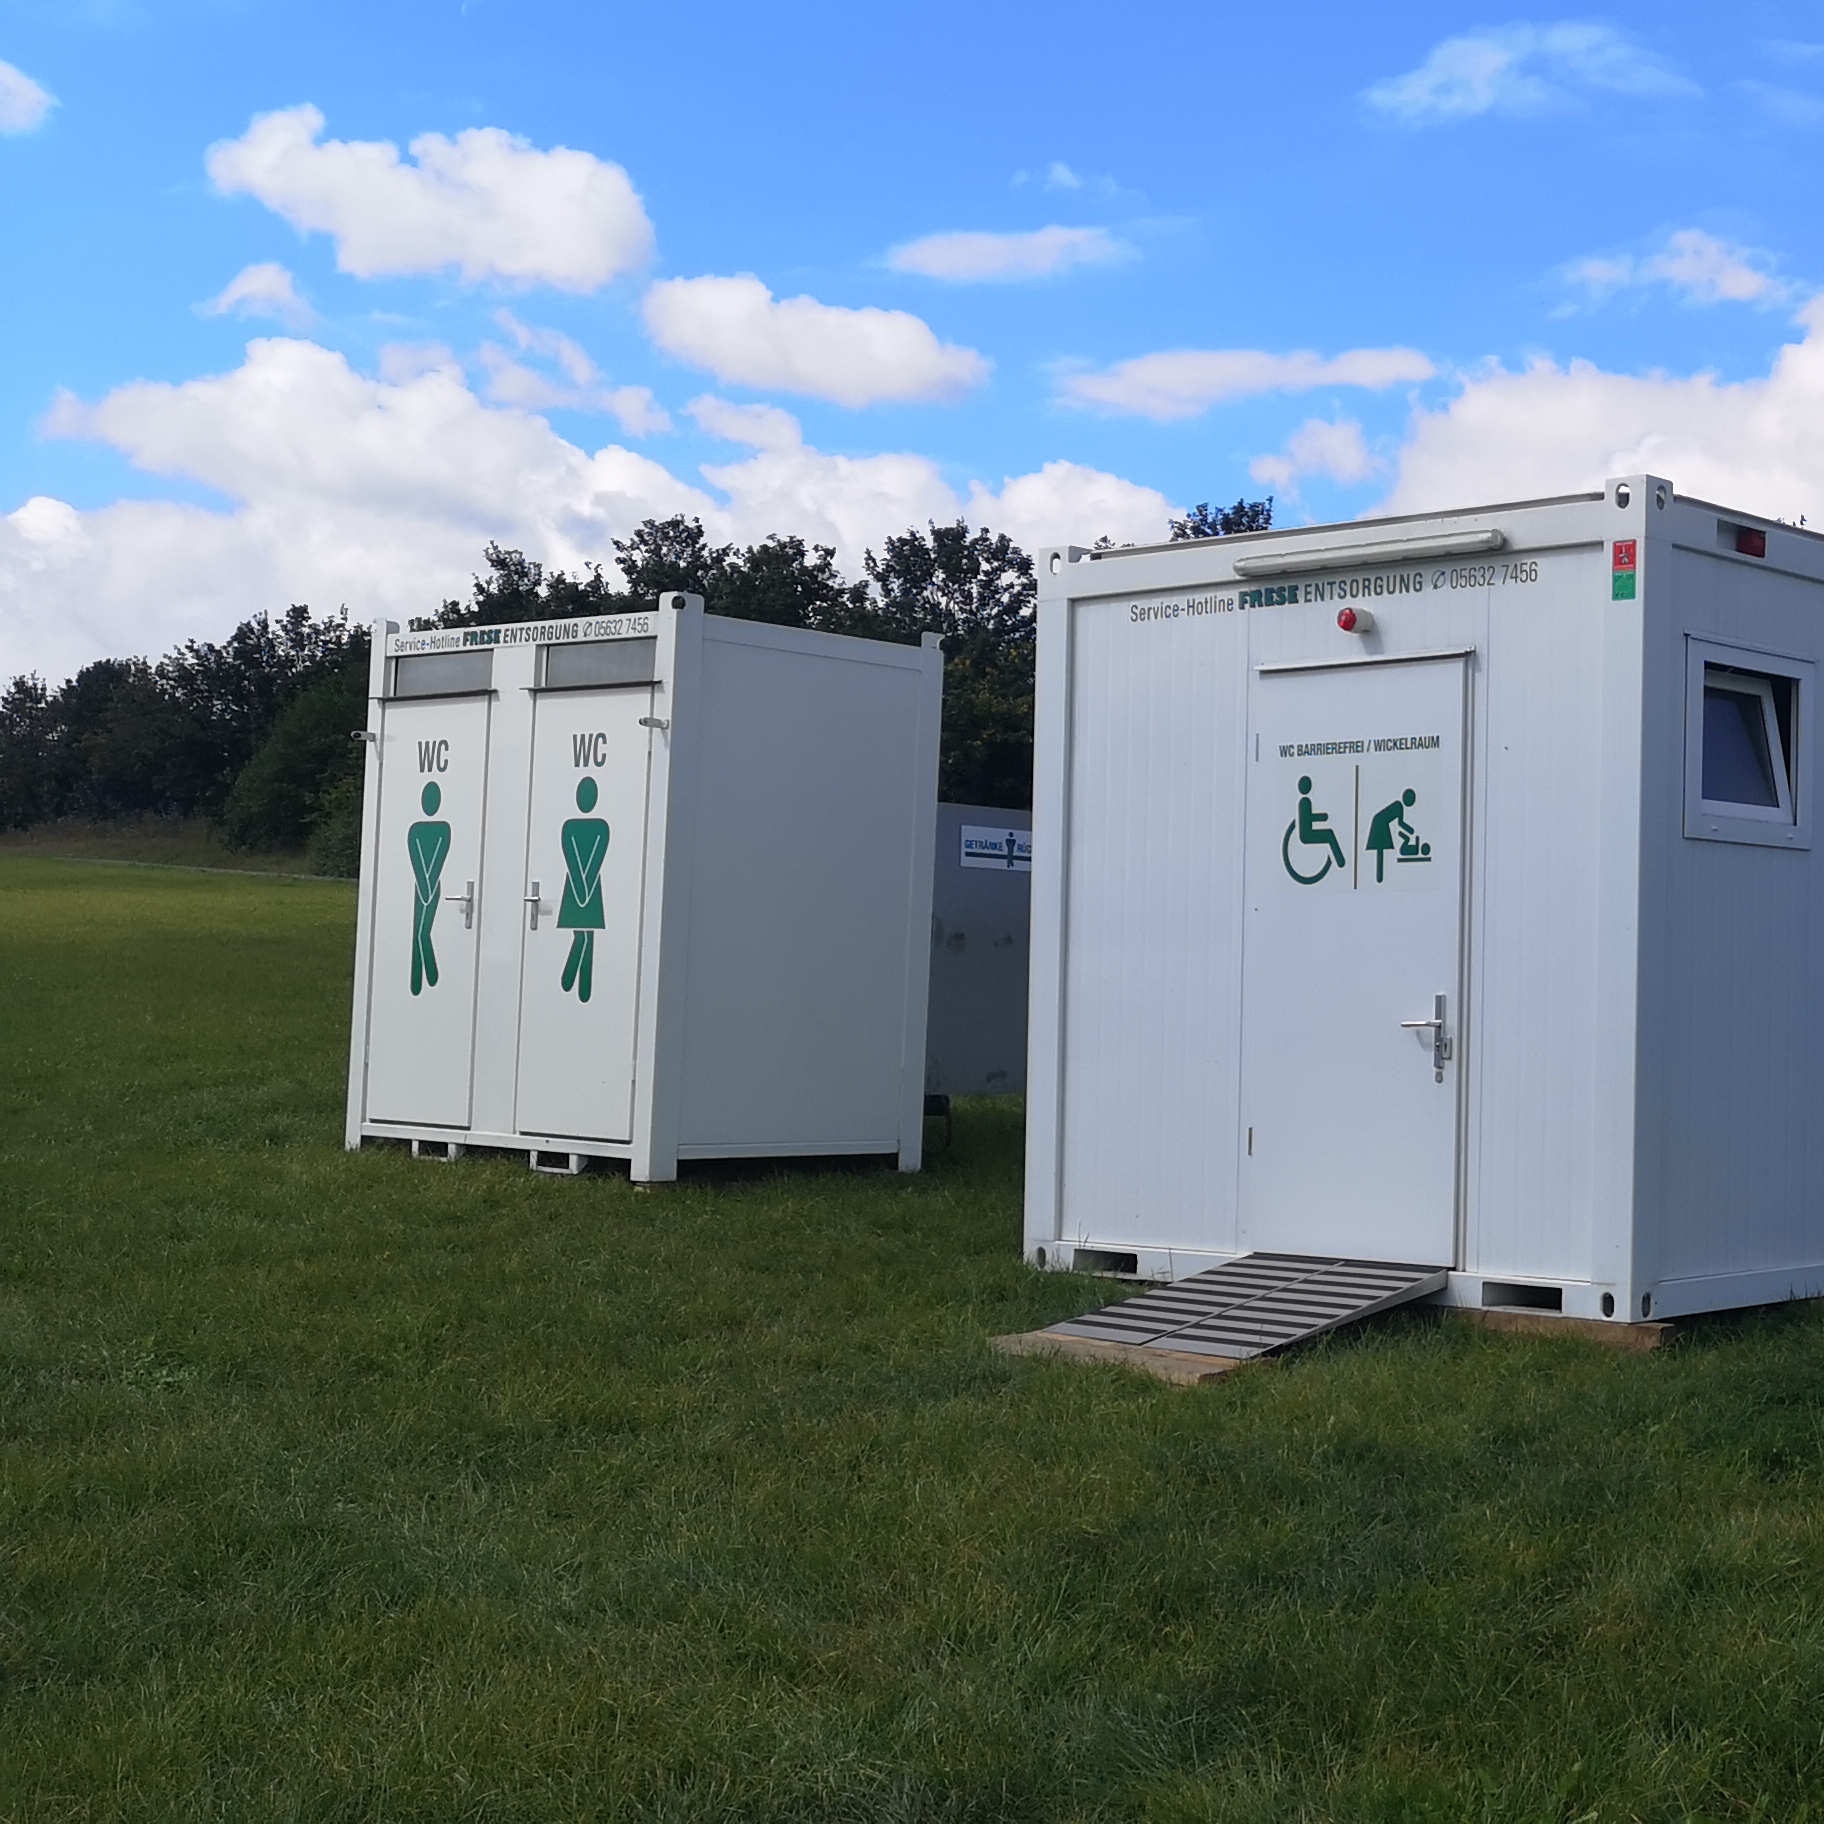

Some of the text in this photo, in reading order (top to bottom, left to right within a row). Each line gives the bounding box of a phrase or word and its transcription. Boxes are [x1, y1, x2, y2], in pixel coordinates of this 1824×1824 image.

[1130, 561, 1538, 622] Service-Hotline FRESE ENTSORGUNG 05632 7456
[394, 616, 649, 653] Service-Hotline FRESE ENTSORGUNG 05632 7456
[417, 739, 449, 773] WC
[572, 732, 607, 768] WC
[1279, 744, 1295, 758] WC
[1296, 739, 1364, 757] BARRIEREFREI
[1373, 735, 1440, 752] WICKELRAUM
